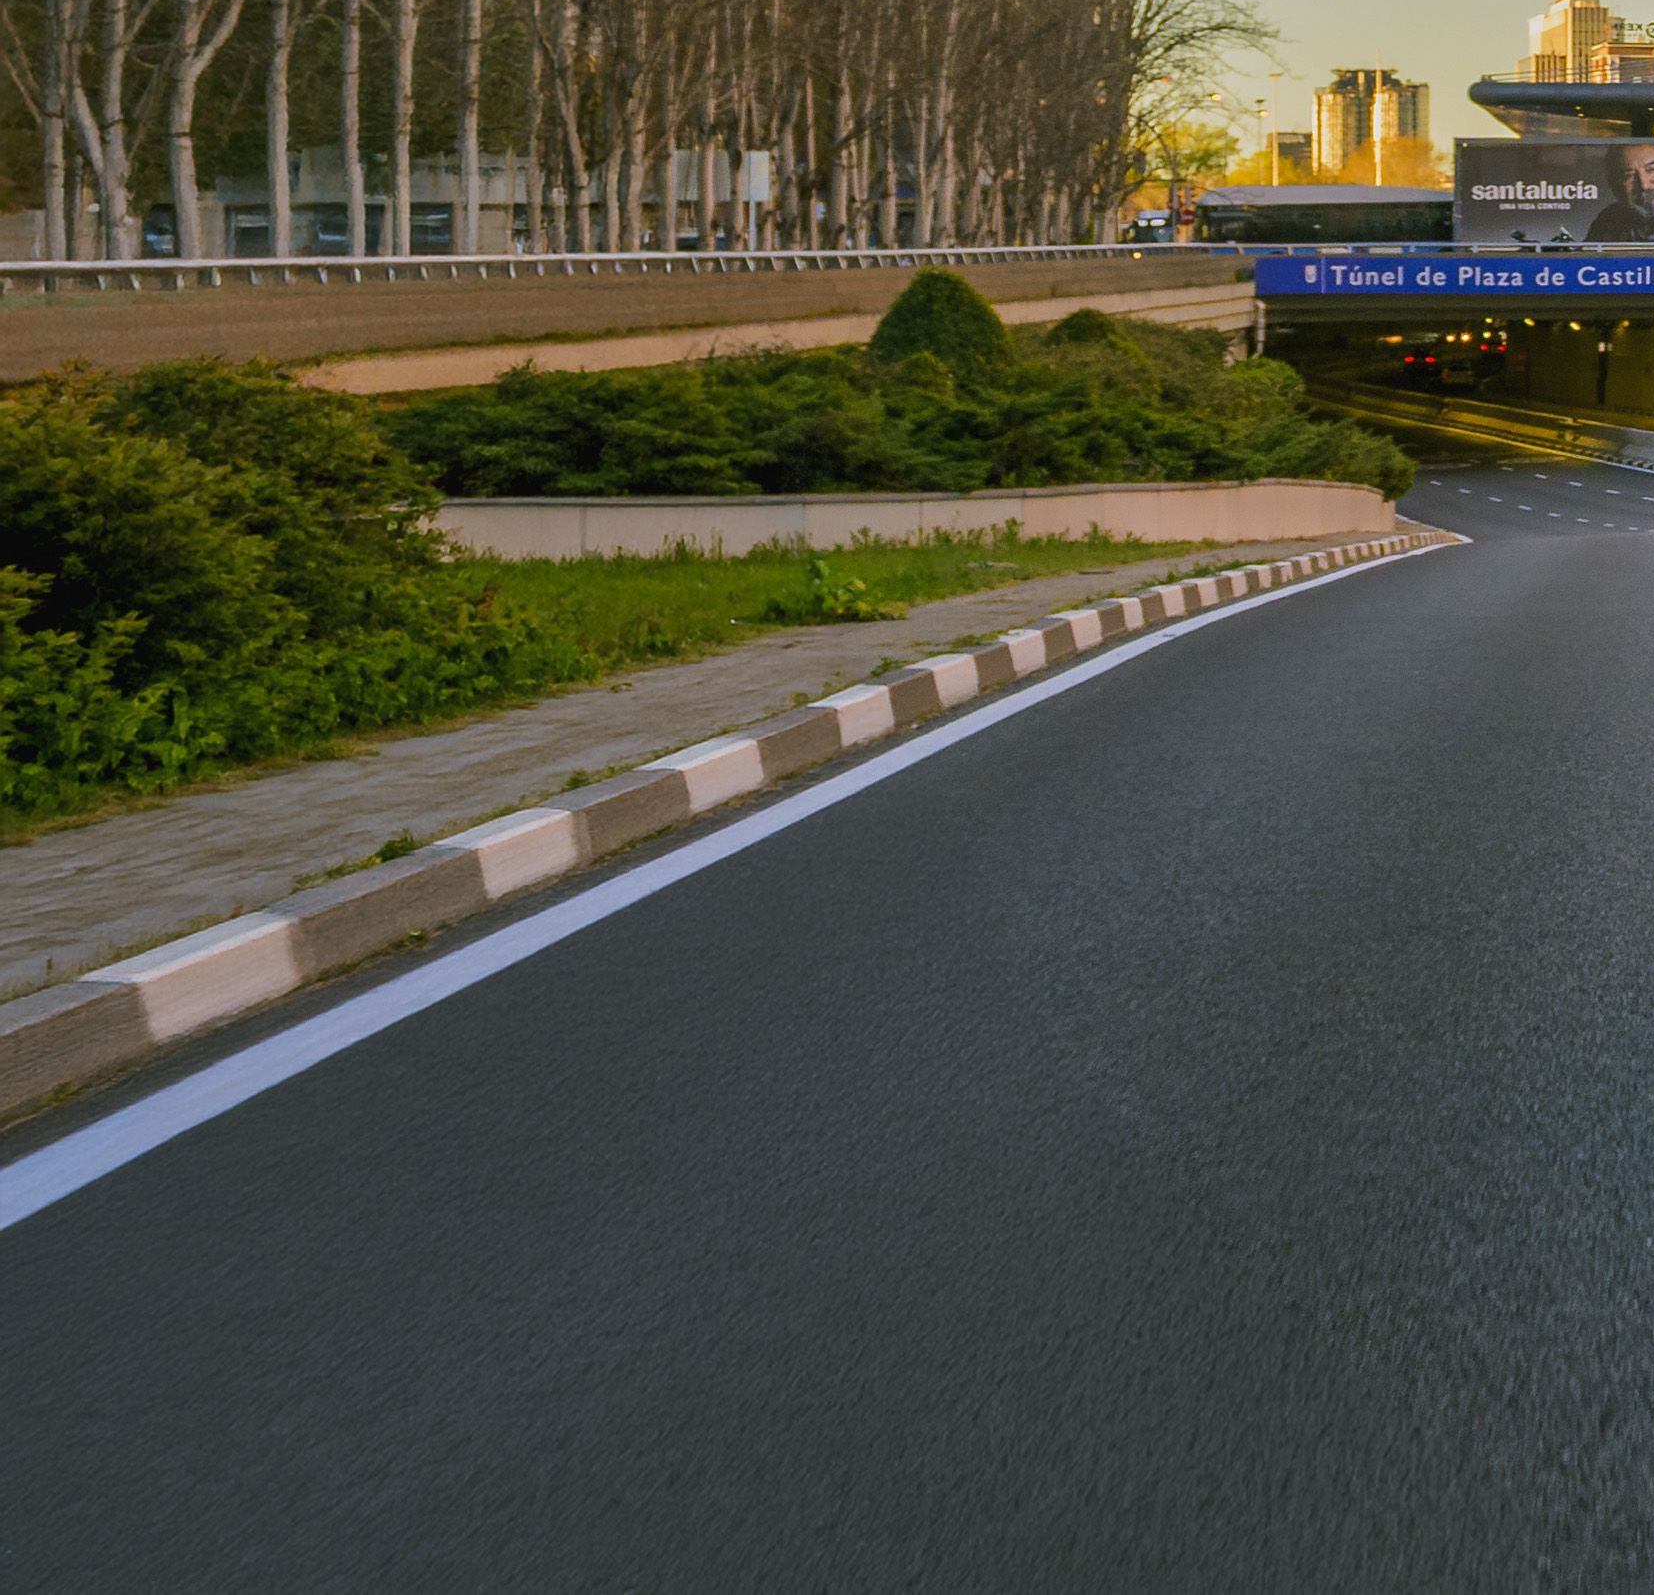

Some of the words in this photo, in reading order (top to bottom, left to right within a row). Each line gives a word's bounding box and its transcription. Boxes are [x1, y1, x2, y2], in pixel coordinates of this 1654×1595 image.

[1471, 180, 1598, 201] santalucía
[1330, 265, 1404, 286] Túnel
[1416, 266, 1447, 286] de
[1458, 266, 1524, 286] Plaza
[1535, 266, 1565, 286] de
